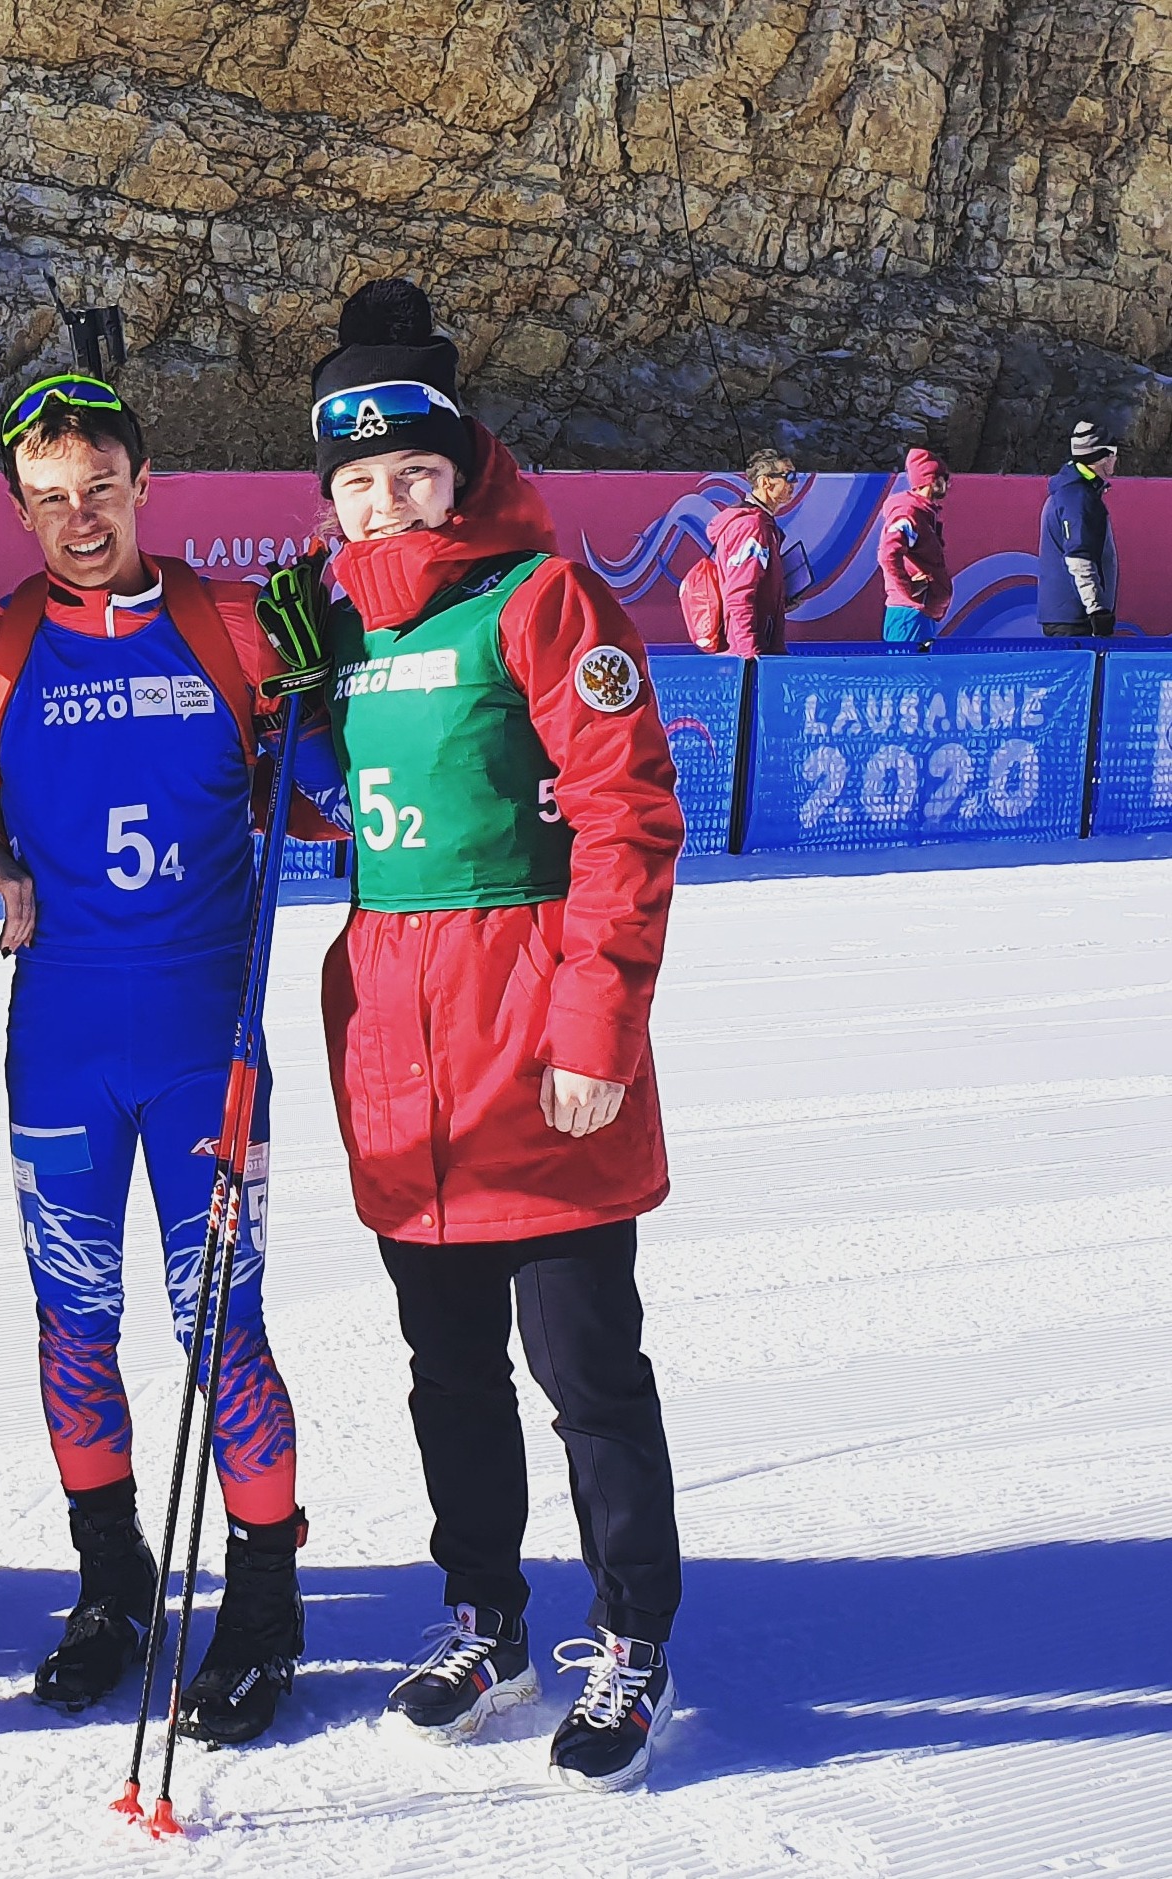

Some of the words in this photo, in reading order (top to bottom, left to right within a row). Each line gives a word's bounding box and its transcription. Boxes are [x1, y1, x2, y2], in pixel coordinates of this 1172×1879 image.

[333, 670, 388, 701] 2020
[337, 656, 393, 678] LAUSANNE
[42, 678, 126, 699] LAUSANNE
[43, 694, 128, 726] 2020
[802, 684, 1048, 738] LAUSANNE
[798, 738, 1041, 828] 2020
[358, 767, 398, 852] 5
[106, 803, 156, 891] 5
[228, 1667, 261, 1707] ATOMIC
